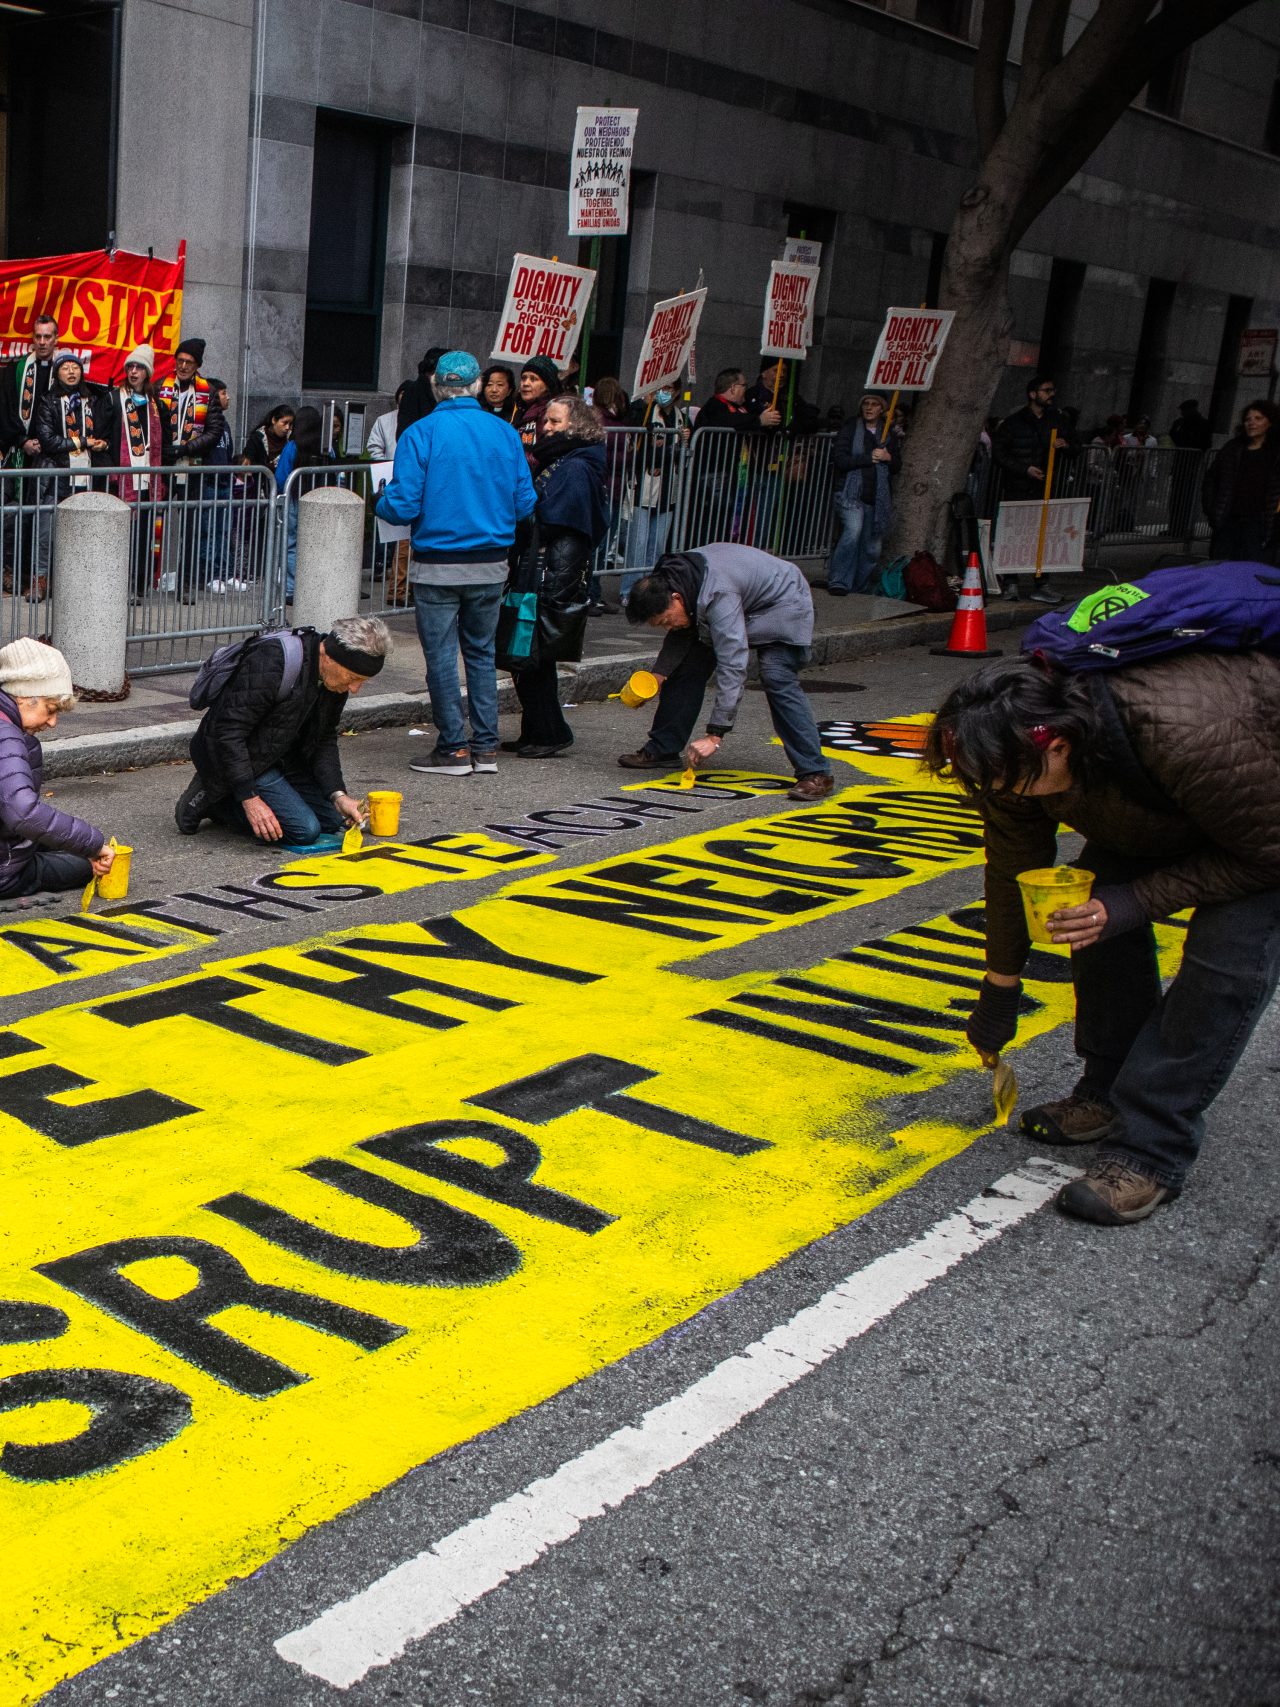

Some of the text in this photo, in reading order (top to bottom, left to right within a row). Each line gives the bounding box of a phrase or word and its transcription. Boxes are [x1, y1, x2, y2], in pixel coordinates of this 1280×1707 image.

[595, 116, 621, 126] PROTECT
[584, 126, 630, 137] OUR NEIGHBORS
[577, 147, 631, 158] NUESTROS VECINOS
[579, 187, 619, 198] KEEP FAMILIES
[585, 197, 613, 207] TOGETHER
[577, 219, 600, 228] FAMILIAS
[513, 267, 582, 307] DIGNITY
[771, 272, 811, 303] DIGNITY
[516, 299, 570, 318] & HUMAN
[773, 301, 804, 314] & HUMAN
[518, 312, 560, 329] RIGHTS
[650, 299, 698, 339] DIGNITY
[775, 312, 799, 322] RIGHTS
[652, 327, 685, 348] & HUMAN
[767, 320, 803, 349] FOR ALL
[886, 316, 943, 342] DIGNITY
[500, 322, 567, 360] FOR ALL
[652, 342, 679, 357] RIGHTS
[886, 342, 930, 352] & HUMAN
[888, 352, 923, 361] RIGHTS
[640, 355, 665, 388] FOR
[661, 346, 682, 377] ALL
[873, 360, 928, 385] FOR ALL
[338, 796, 704, 875] TEACH
[645, 773, 796, 800] US
[90, 915, 607, 1066] THY
